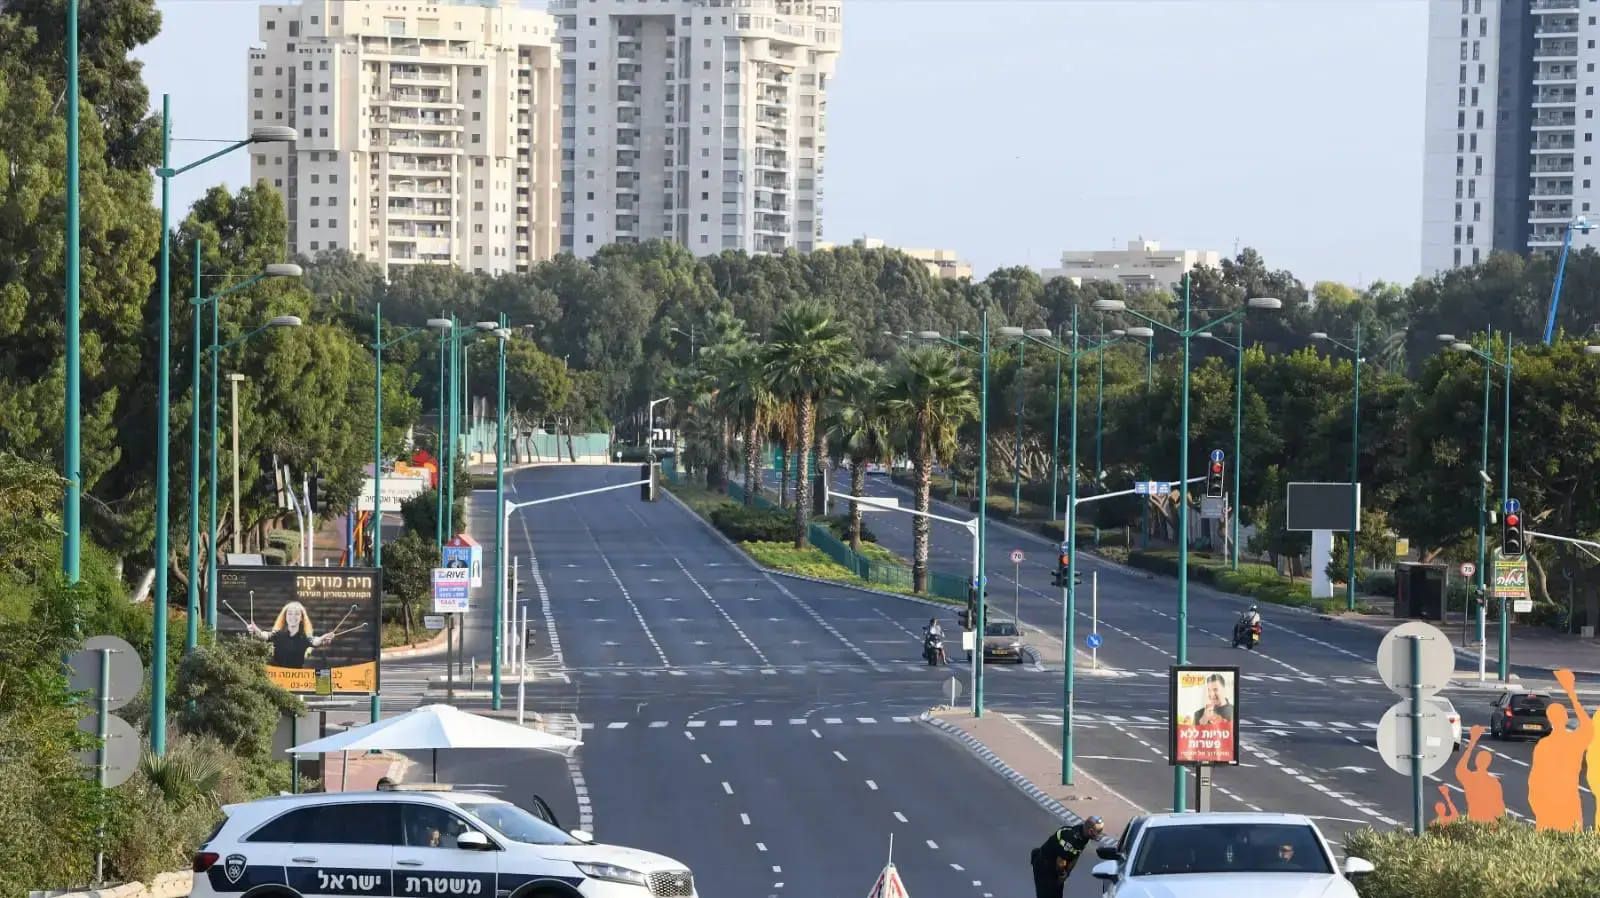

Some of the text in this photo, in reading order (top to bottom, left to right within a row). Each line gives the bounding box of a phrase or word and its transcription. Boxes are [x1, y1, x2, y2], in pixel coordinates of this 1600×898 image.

[296, 575, 372, 589] חיה מוזיקה
[323, 591, 372, 599] הקונסרבטוריון
[279, 671, 311, 679] התאמה
[1180, 727, 1230, 739] טריות ללא
[1187, 739, 1221, 749] פשרות
[317, 869, 482, 895] משטרת ישראל
